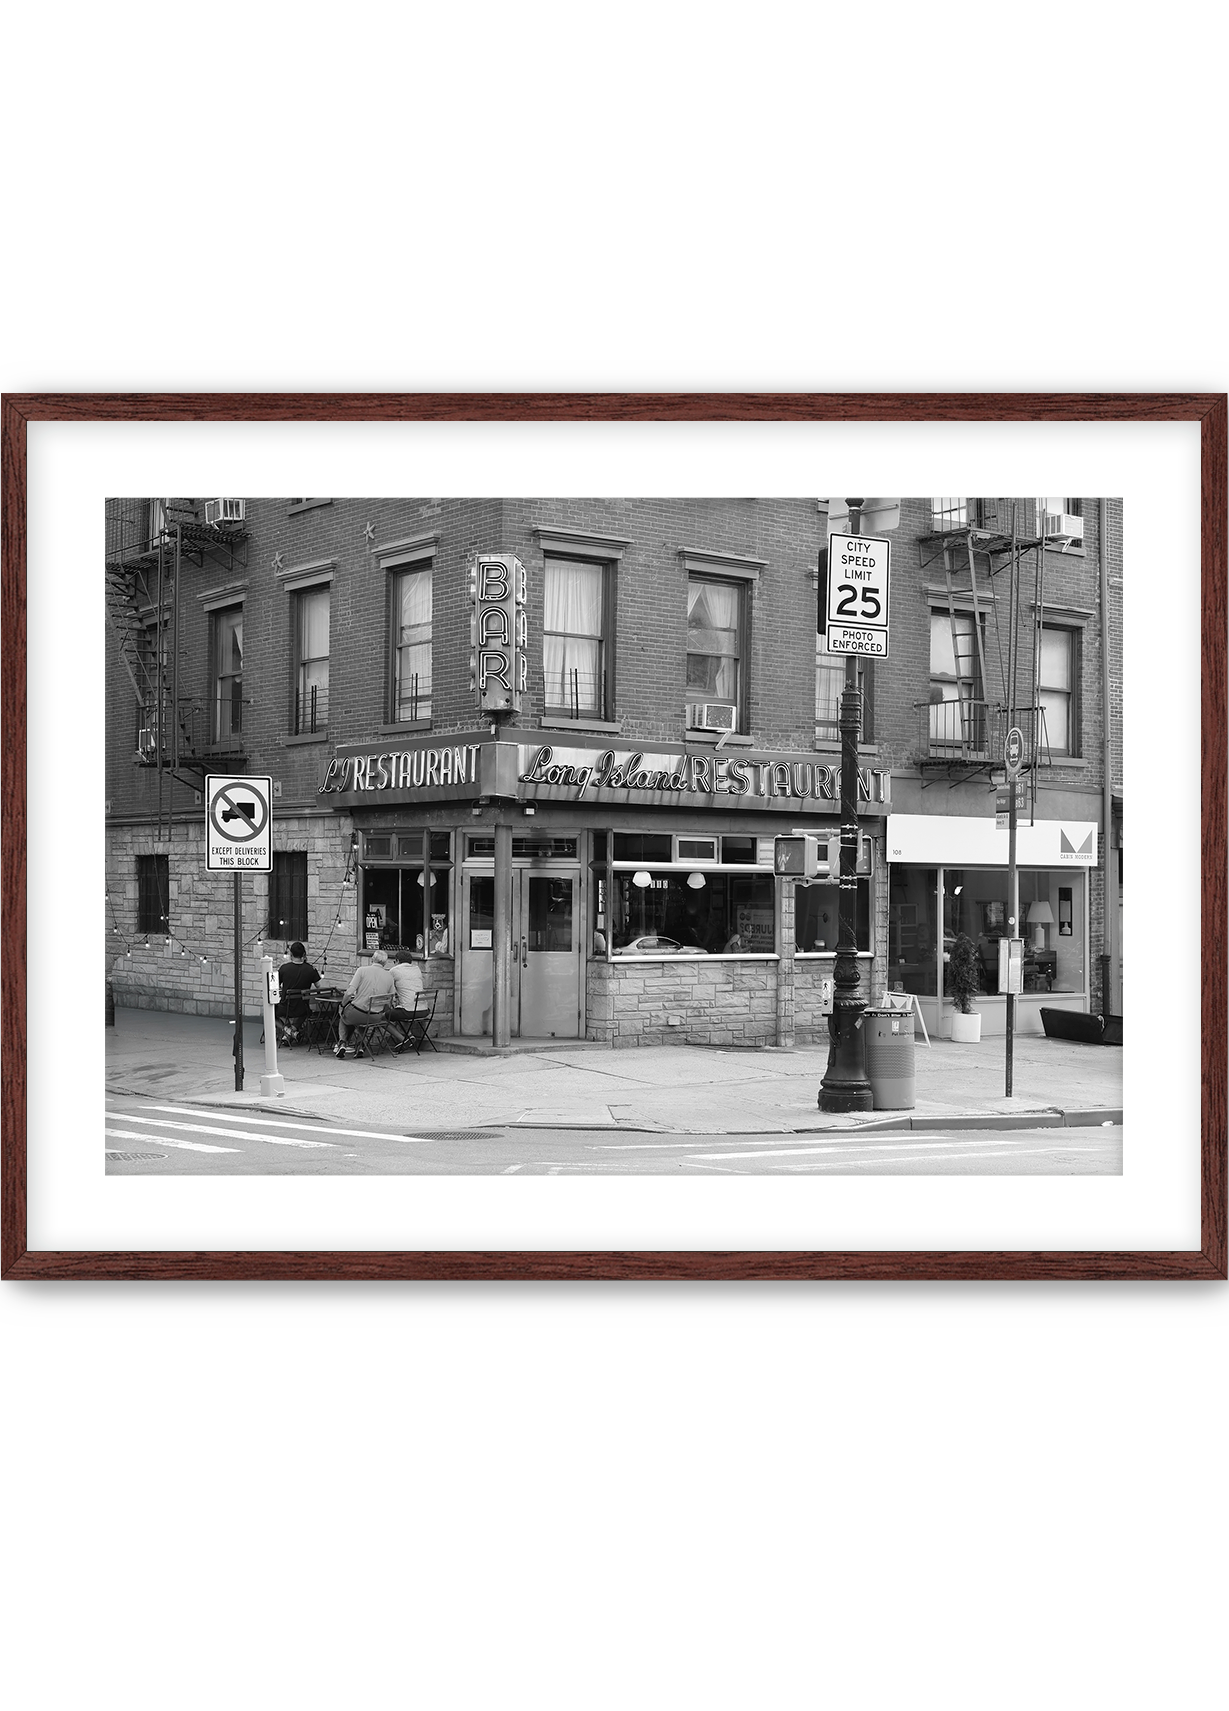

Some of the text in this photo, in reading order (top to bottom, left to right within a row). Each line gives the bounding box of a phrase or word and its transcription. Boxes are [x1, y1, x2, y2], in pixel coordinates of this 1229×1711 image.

[847, 541, 871, 554] CITY
[841, 554, 876, 568] SPEED
[845, 569, 872, 581] LIMIT
[837, 584, 881, 618] 25
[479, 562, 512, 690] BAR
[843, 630, 873, 641] PHOTO
[833, 639, 883, 653] ENFORCED
[354, 744, 480, 792] RESTAURANT
[522, 745, 594, 799] Long
[596, 750, 689, 790] Island
[212, 846, 266, 856] EXCEPT DELIVERIES
[220, 857, 259, 866] THIS BLOCK
